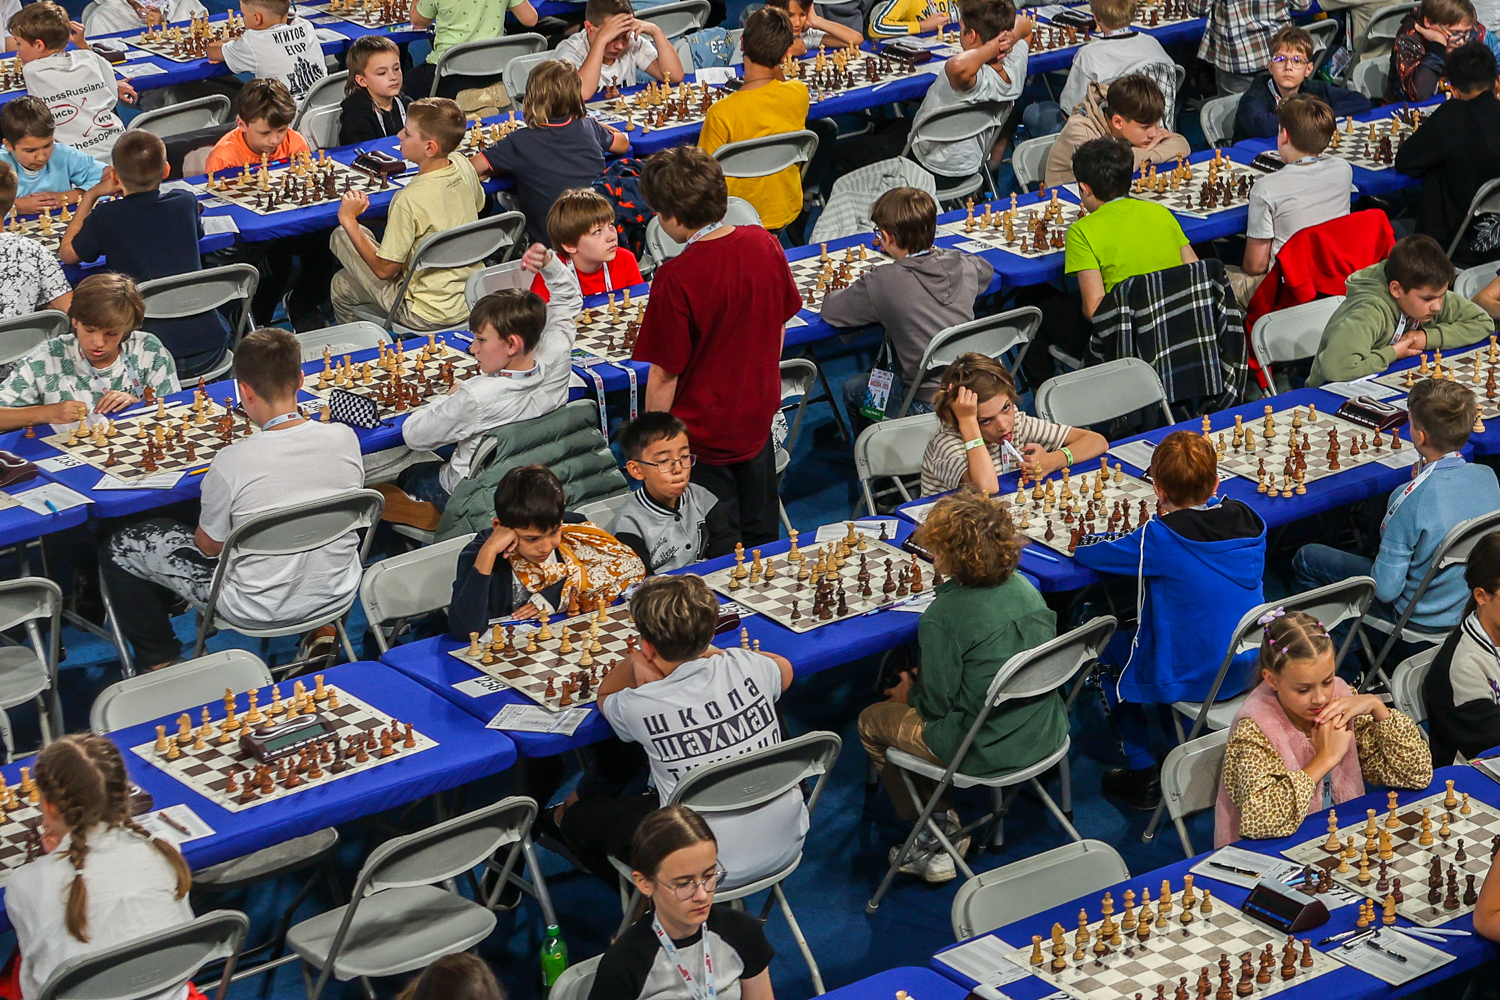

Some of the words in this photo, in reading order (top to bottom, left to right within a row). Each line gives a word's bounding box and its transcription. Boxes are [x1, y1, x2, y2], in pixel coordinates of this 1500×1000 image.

[285, 42, 306, 56] ЕГОР
[52, 455, 82, 467] 235
[474, 676, 506, 691] 258
